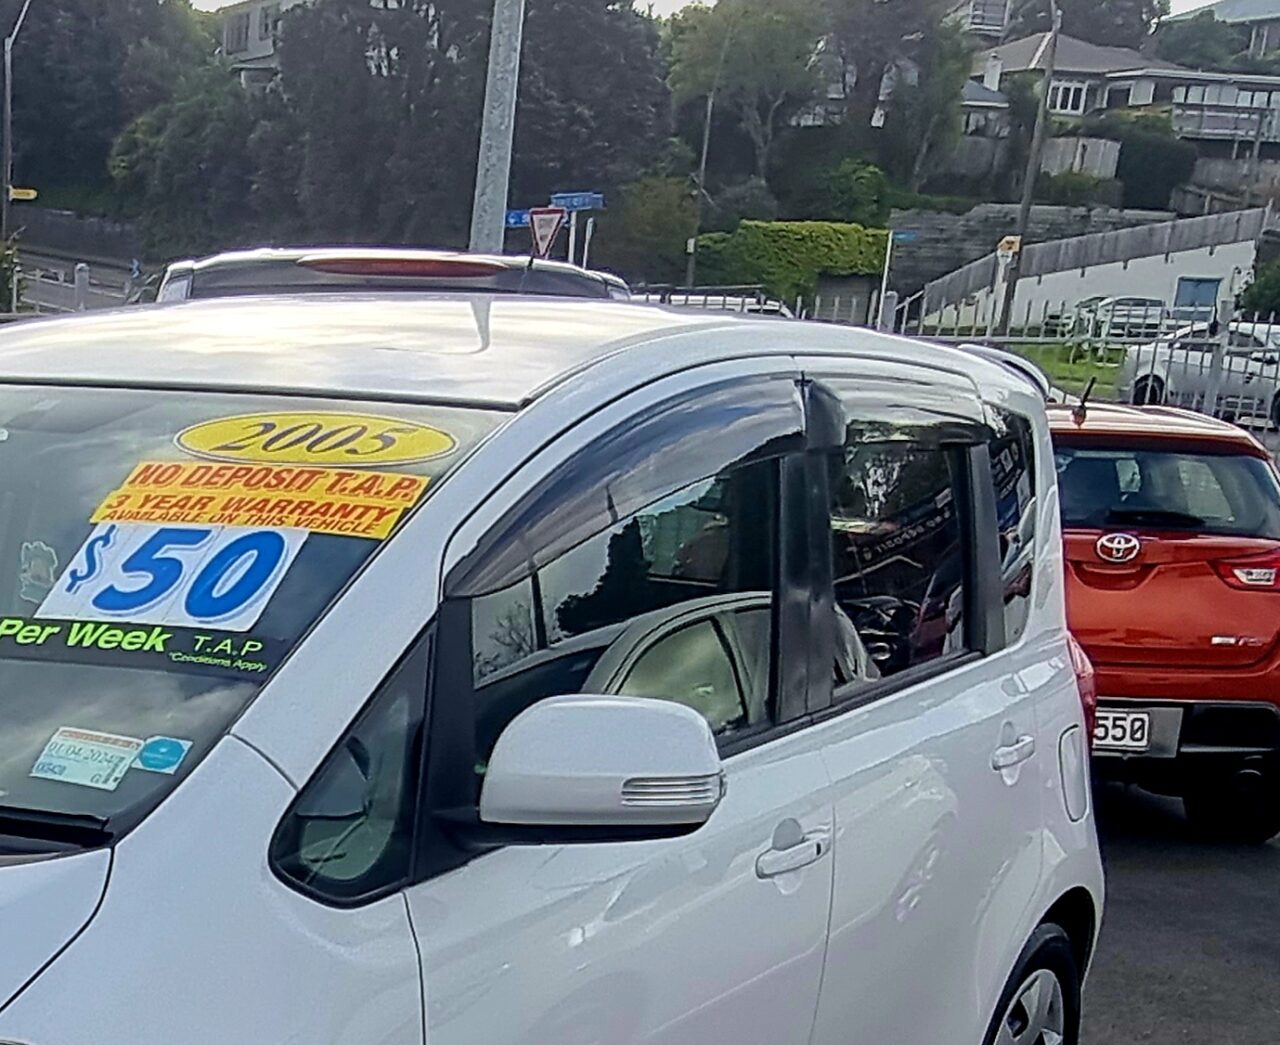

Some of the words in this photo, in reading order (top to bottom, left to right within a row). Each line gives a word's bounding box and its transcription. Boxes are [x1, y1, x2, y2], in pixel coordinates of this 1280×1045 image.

[208, 422, 419, 455] 2005
[128, 464, 181, 489] NO
[180, 465, 328, 492] DEPOSIT
[324, 472, 420, 500] T.A.P.
[106, 494, 131, 509] 3
[137, 494, 217, 511] YEAR
[220, 497, 399, 522] WARRANTY
[100, 510, 207, 523] AVAILABLE
[208, 512, 239, 524] ON
[244, 514, 289, 527] THIS
[293, 516, 380, 535] VEHICLE
[67, 622, 173, 652] Week
[194, 635, 263, 656] T.A.P
[233, 660, 267, 672] Apply
[1095, 716, 1146, 743] 550
